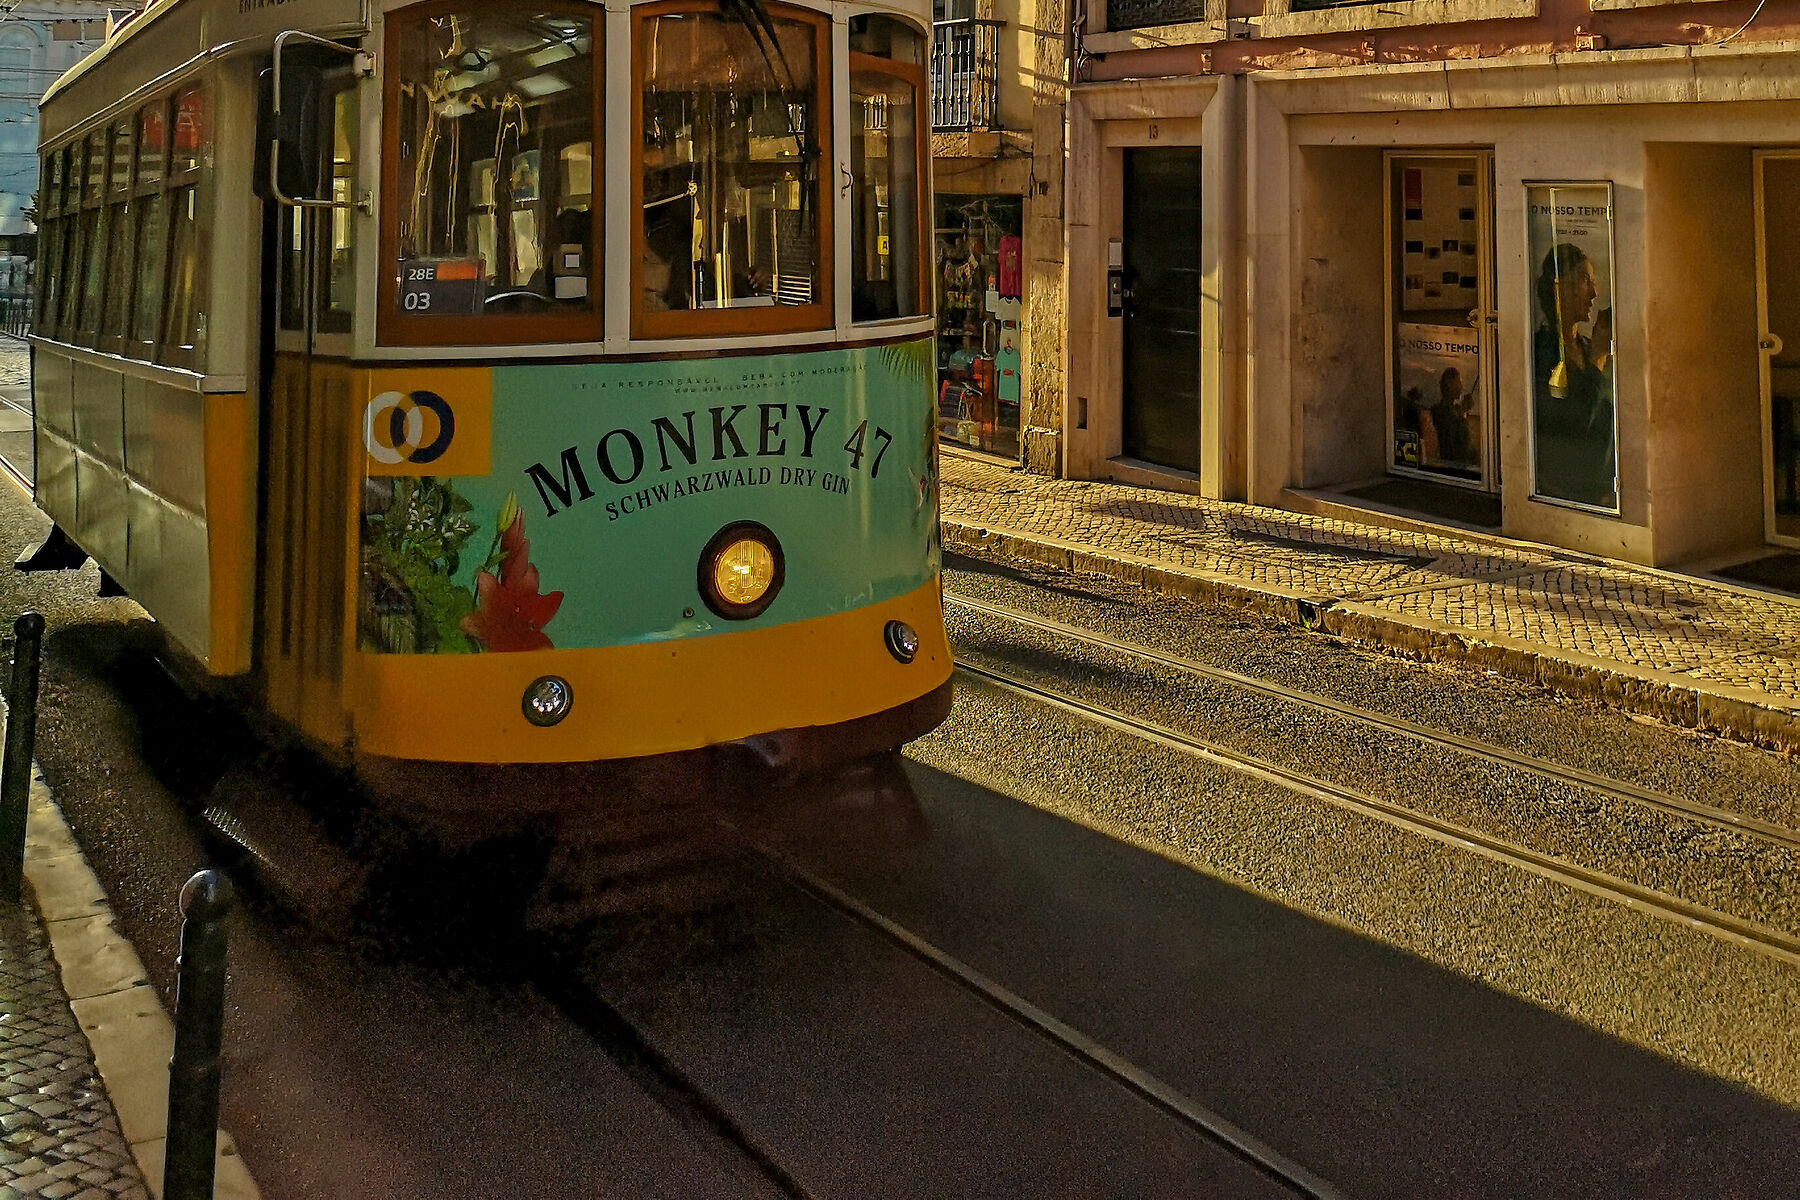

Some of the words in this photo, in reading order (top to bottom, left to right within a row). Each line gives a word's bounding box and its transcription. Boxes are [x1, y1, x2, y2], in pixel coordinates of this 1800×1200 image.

[1541, 206, 1575, 216] NOSSO
[408, 268, 435, 281] 28E
[404, 292, 431, 311] 03
[1408, 340, 1442, 351] NOSSO
[1444, 343, 1479, 355] TEMPO
[524, 403, 830, 518] MONKEY
[843, 419, 893, 479] 47
[604, 467, 771, 522] SCHWARZWALD
[779, 466, 817, 487] DRY
[822, 473, 851, 496] GIN
